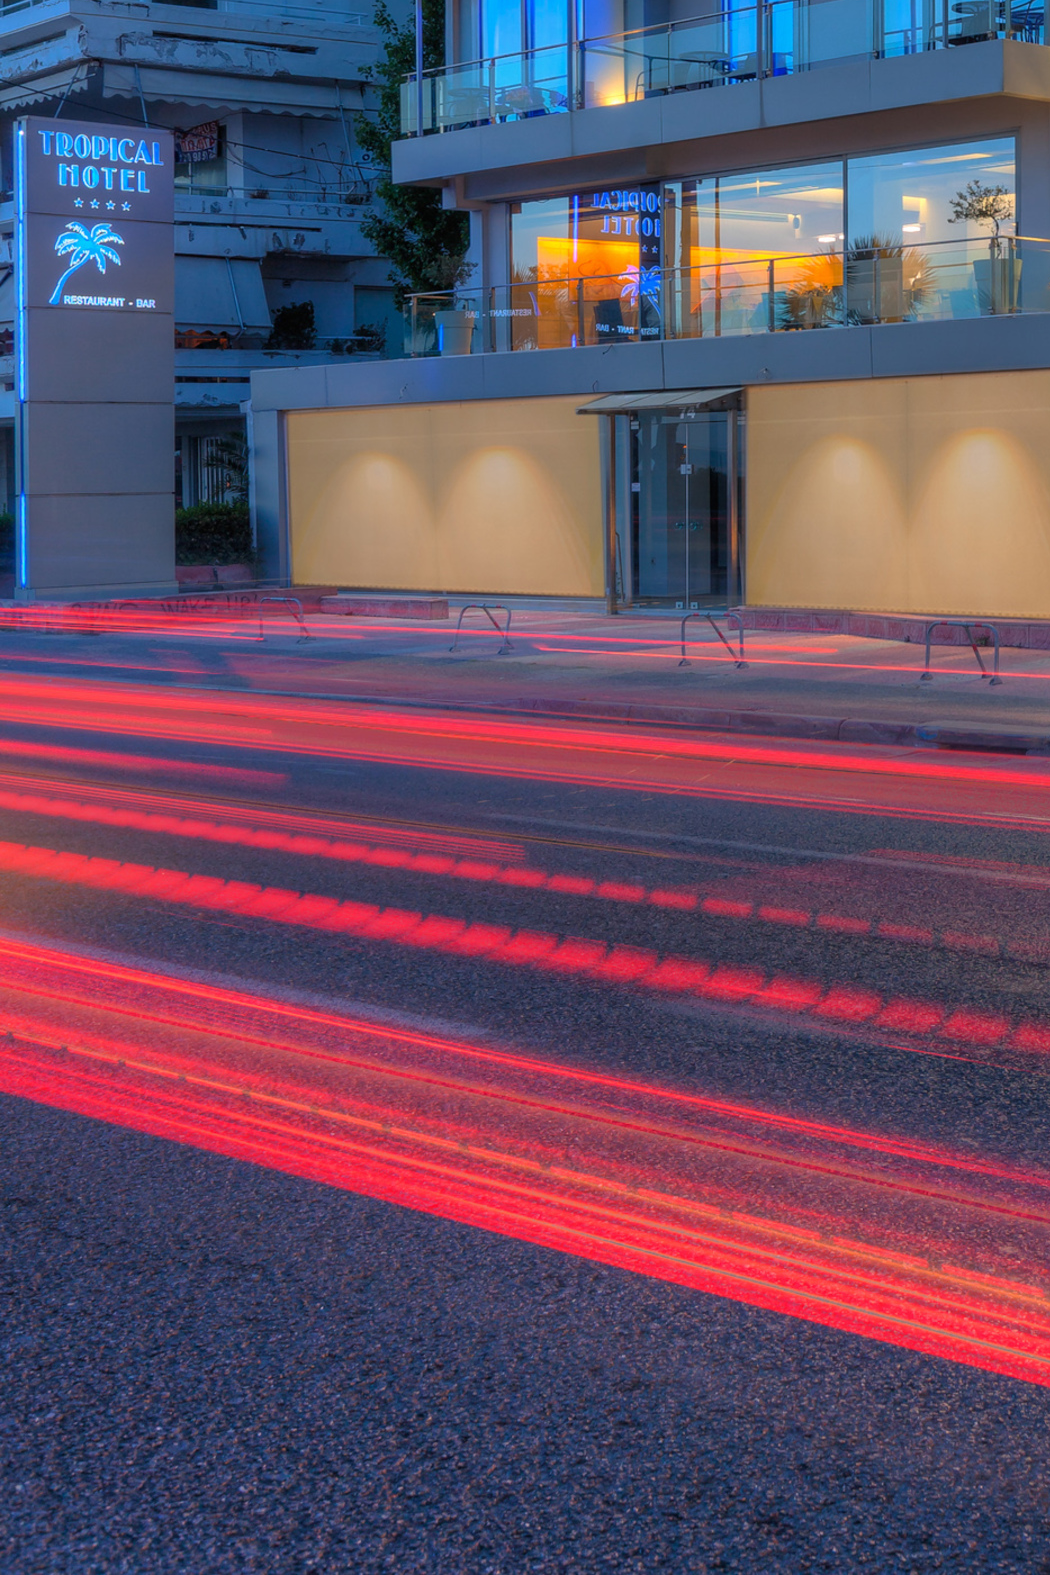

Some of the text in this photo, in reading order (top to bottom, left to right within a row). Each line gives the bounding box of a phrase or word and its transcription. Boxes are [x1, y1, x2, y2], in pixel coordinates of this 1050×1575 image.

[38, 130, 164, 166] TROPICAL
[58, 163, 150, 193] HOTEL
[63, 295, 125, 307] RESTAURANT
[136, 298, 156, 308] BAR
